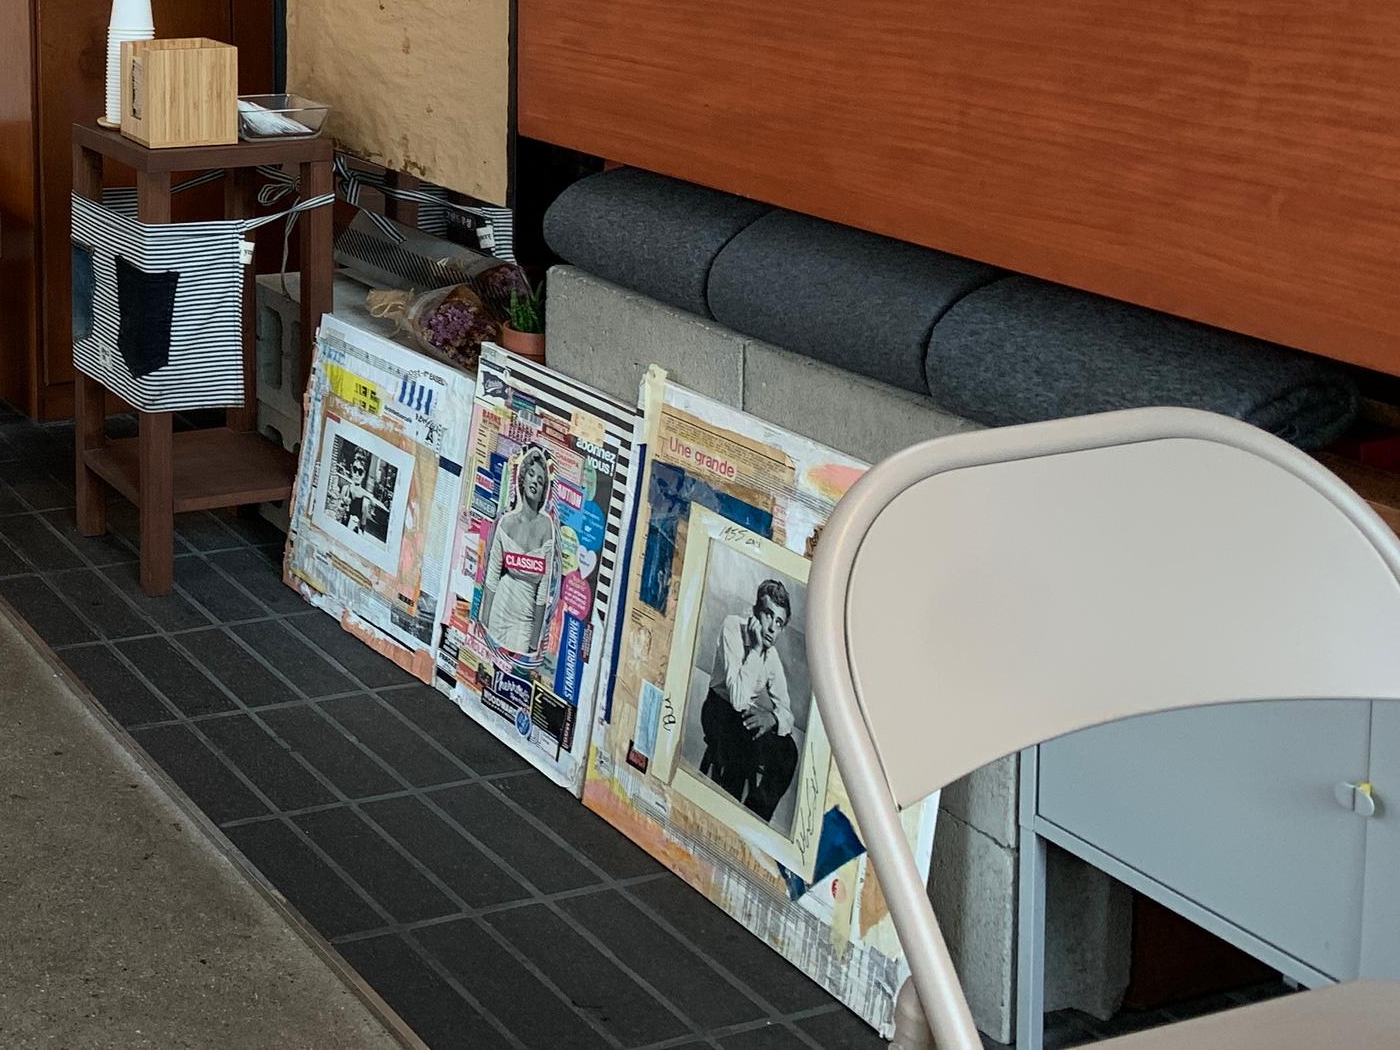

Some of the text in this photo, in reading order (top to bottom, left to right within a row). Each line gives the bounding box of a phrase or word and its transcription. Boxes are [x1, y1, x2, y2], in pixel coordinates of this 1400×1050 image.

[576, 437, 616, 461] abonnez
[669, 436, 735, 478] Une grande
[587, 455, 615, 477] vous!
[505, 554, 545, 572] CLASSICS
[568, 617, 580, 648] CURVE
[564, 648, 578, 701] STANDARD
